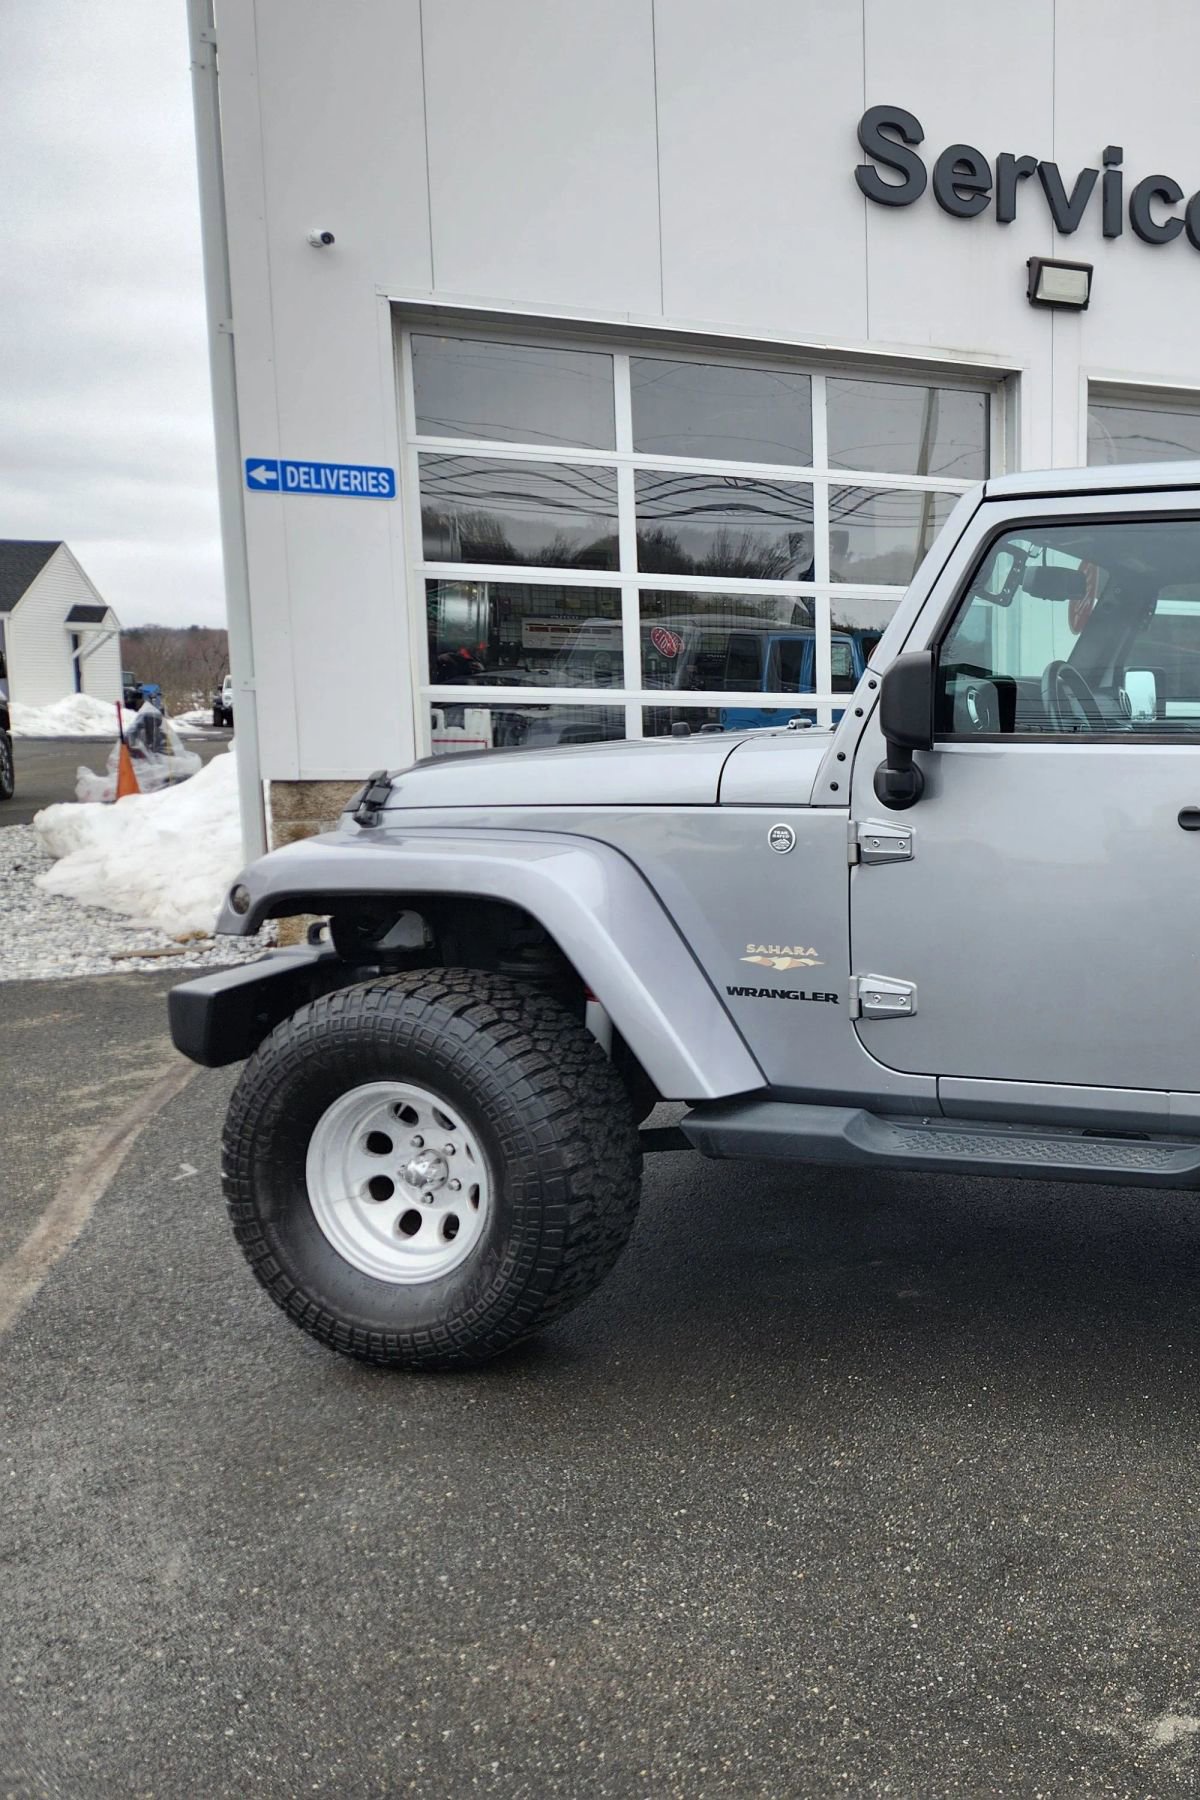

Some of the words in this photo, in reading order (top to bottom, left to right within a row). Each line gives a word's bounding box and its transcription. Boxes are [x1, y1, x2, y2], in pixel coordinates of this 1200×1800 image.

[285, 465, 390, 494] DELIVERIES
[746, 943, 819, 957] SAHARA
[726, 985, 840, 1005] WRANGLER
